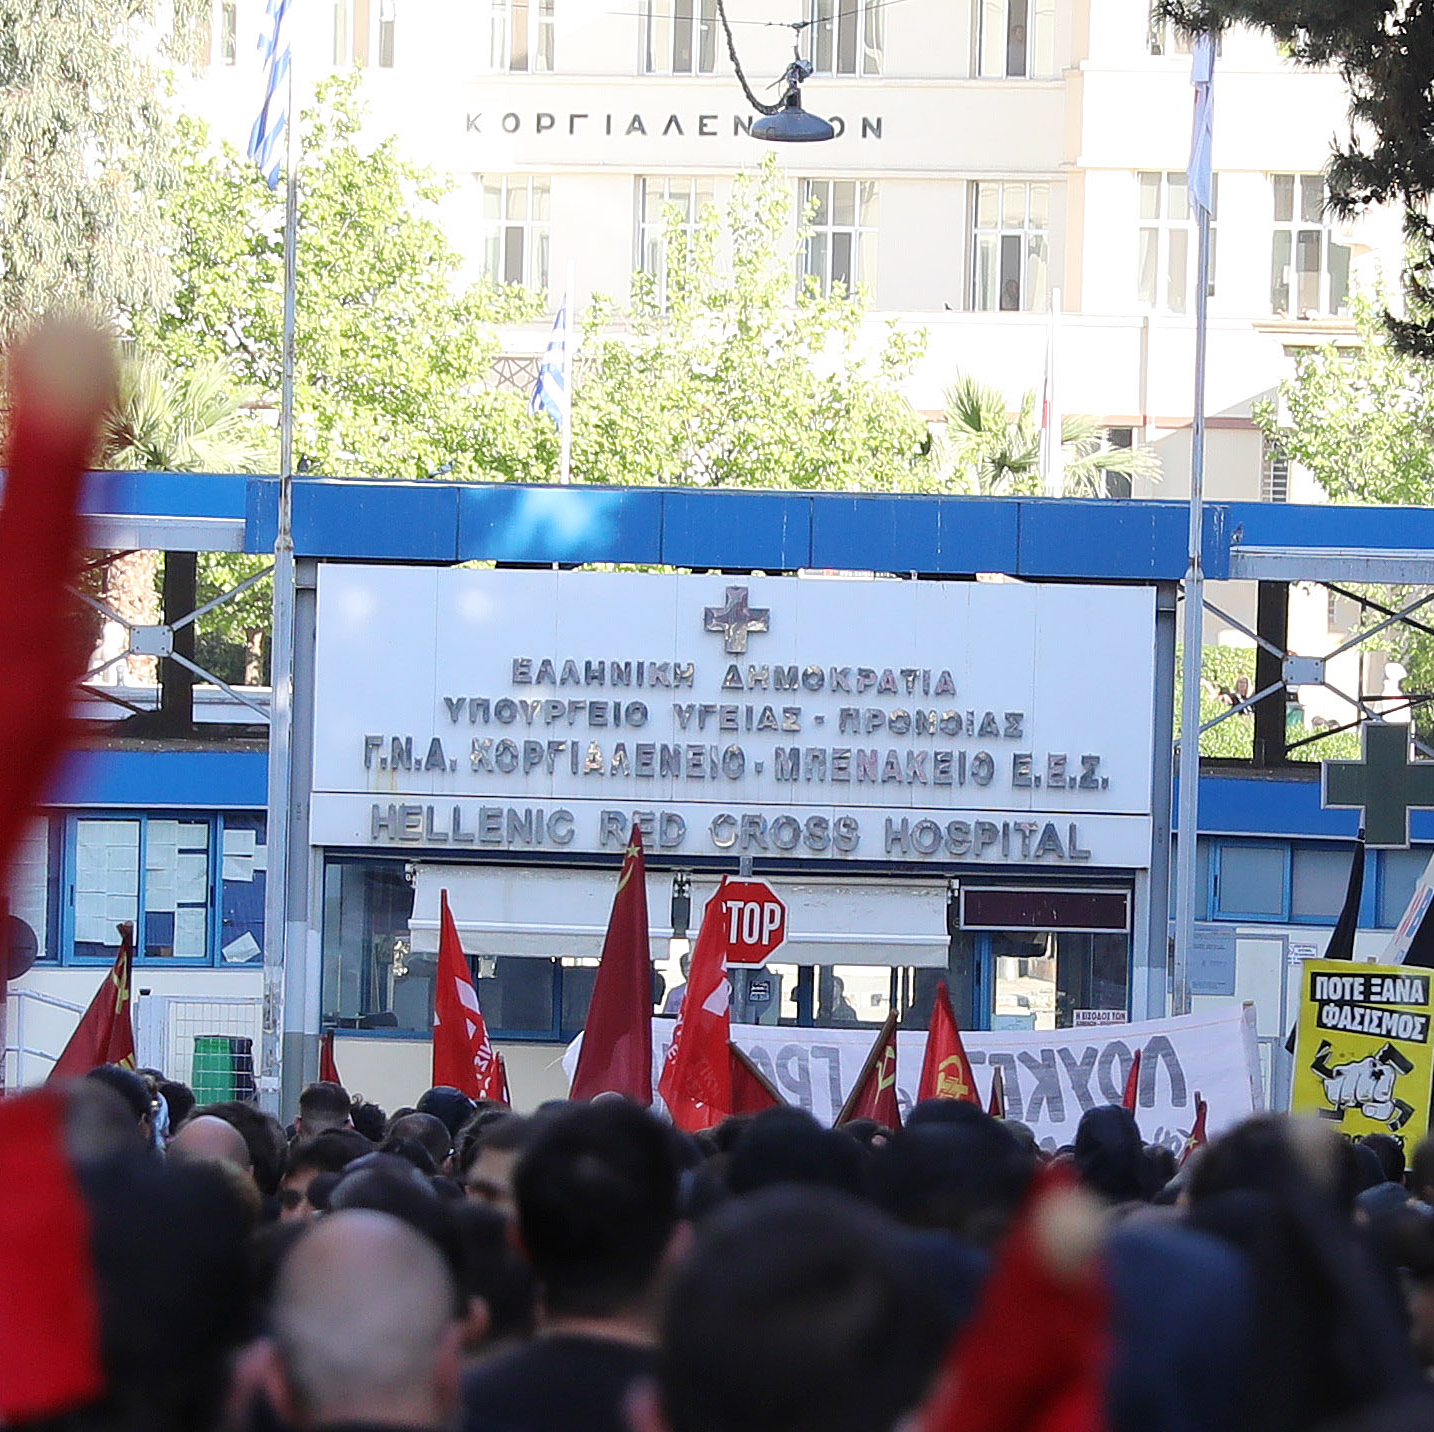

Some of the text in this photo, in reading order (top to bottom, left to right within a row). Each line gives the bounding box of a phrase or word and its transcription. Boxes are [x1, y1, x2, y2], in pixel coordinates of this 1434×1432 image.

[466, 112, 883, 140] ΚΟΡΓΙΑΛΕΝΟΝ
[511, 657, 957, 696] ΕΛΛΗΝΙΚΗ ΔΗΜΟΚΡΑΤΙΑ
[443, 697, 649, 728] ΥΠΟΥΡΓΕΙΟ
[673, 703, 802, 732] ΥΓΕΙΑΣ
[838, 707, 1024, 738] ΠΡΟΝΟΙΑΣ
[364, 734, 458, 773] Γ.Ν.Α.
[469, 737, 746, 780] ΚΟΡΓΙΑΛΕΝΕΙΟ
[774, 745, 995, 786] ΜΠΕΝΑΚΕΙΟ
[370, 803, 1092, 859] HELLENIC RED CROSS HOSPITAL
[722, 900, 782, 945] TOP
[1315, 976, 1426, 1004] ΠΟΤΕ ΞΑΝΑ
[1321, 1002, 1427, 1041] ΦΑΣΙΣΜΟΣ
